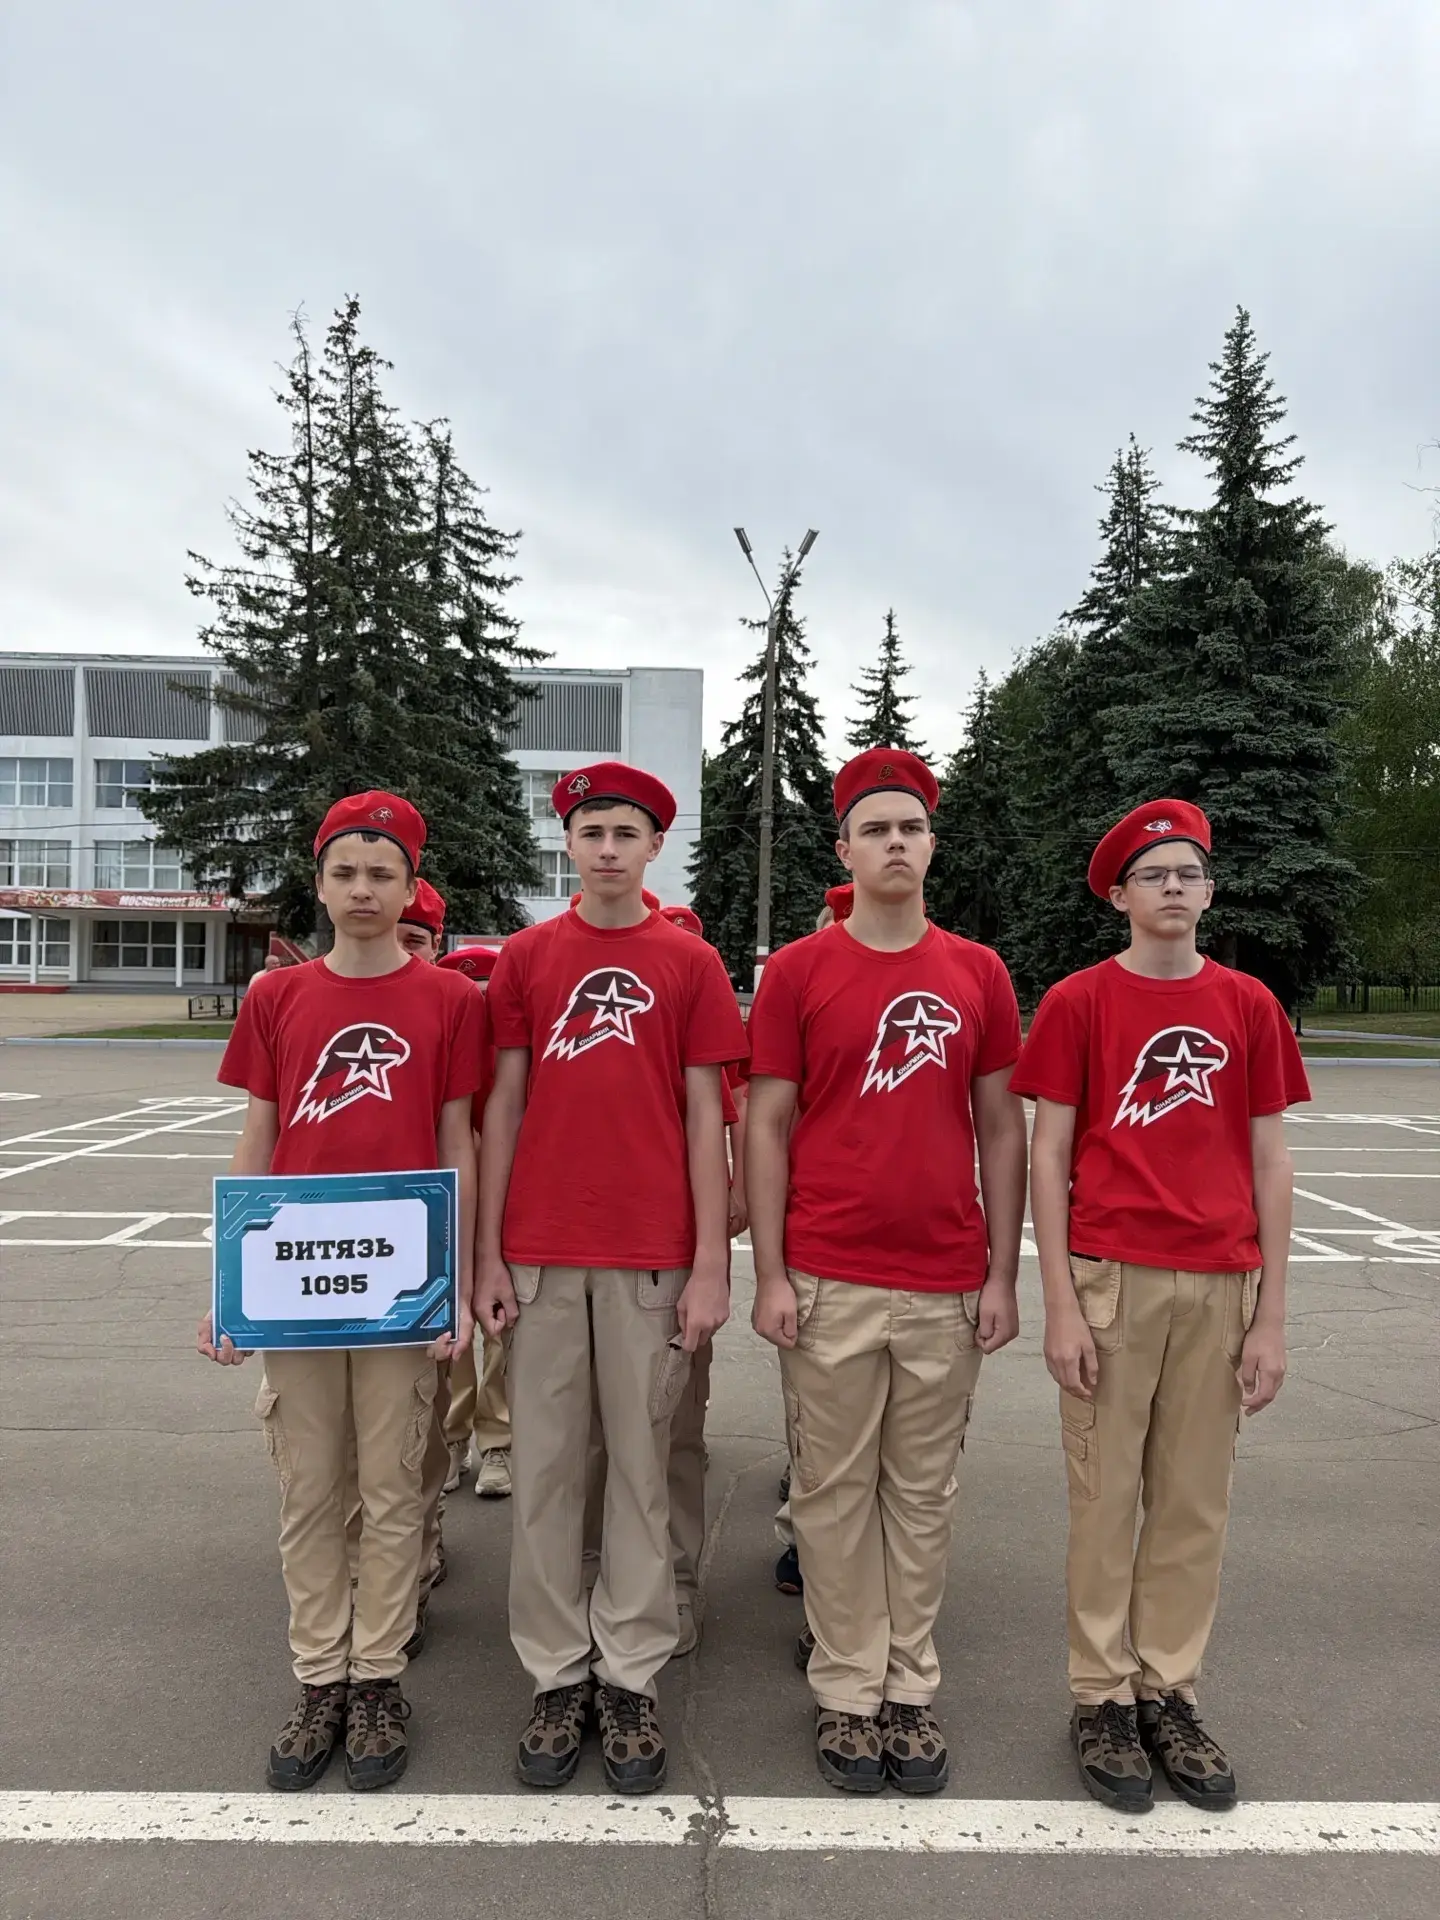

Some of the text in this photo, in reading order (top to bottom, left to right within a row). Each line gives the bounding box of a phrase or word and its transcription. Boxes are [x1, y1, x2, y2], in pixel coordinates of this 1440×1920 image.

[119, 895, 187, 907] МОСКОВСКОЕ
[579, 1027, 610, 1046] ЮНАРМИЯ
[897, 1050, 926, 1076] ЮНАРМИЯ
[330, 1084, 365, 1107] ЮНАРМИЯ
[1154, 1089, 1187, 1111] ЮНАРМИЯ
[275, 1238, 394, 1261] ВИТЯЗЬ
[301, 1274, 368, 1295] 1095
